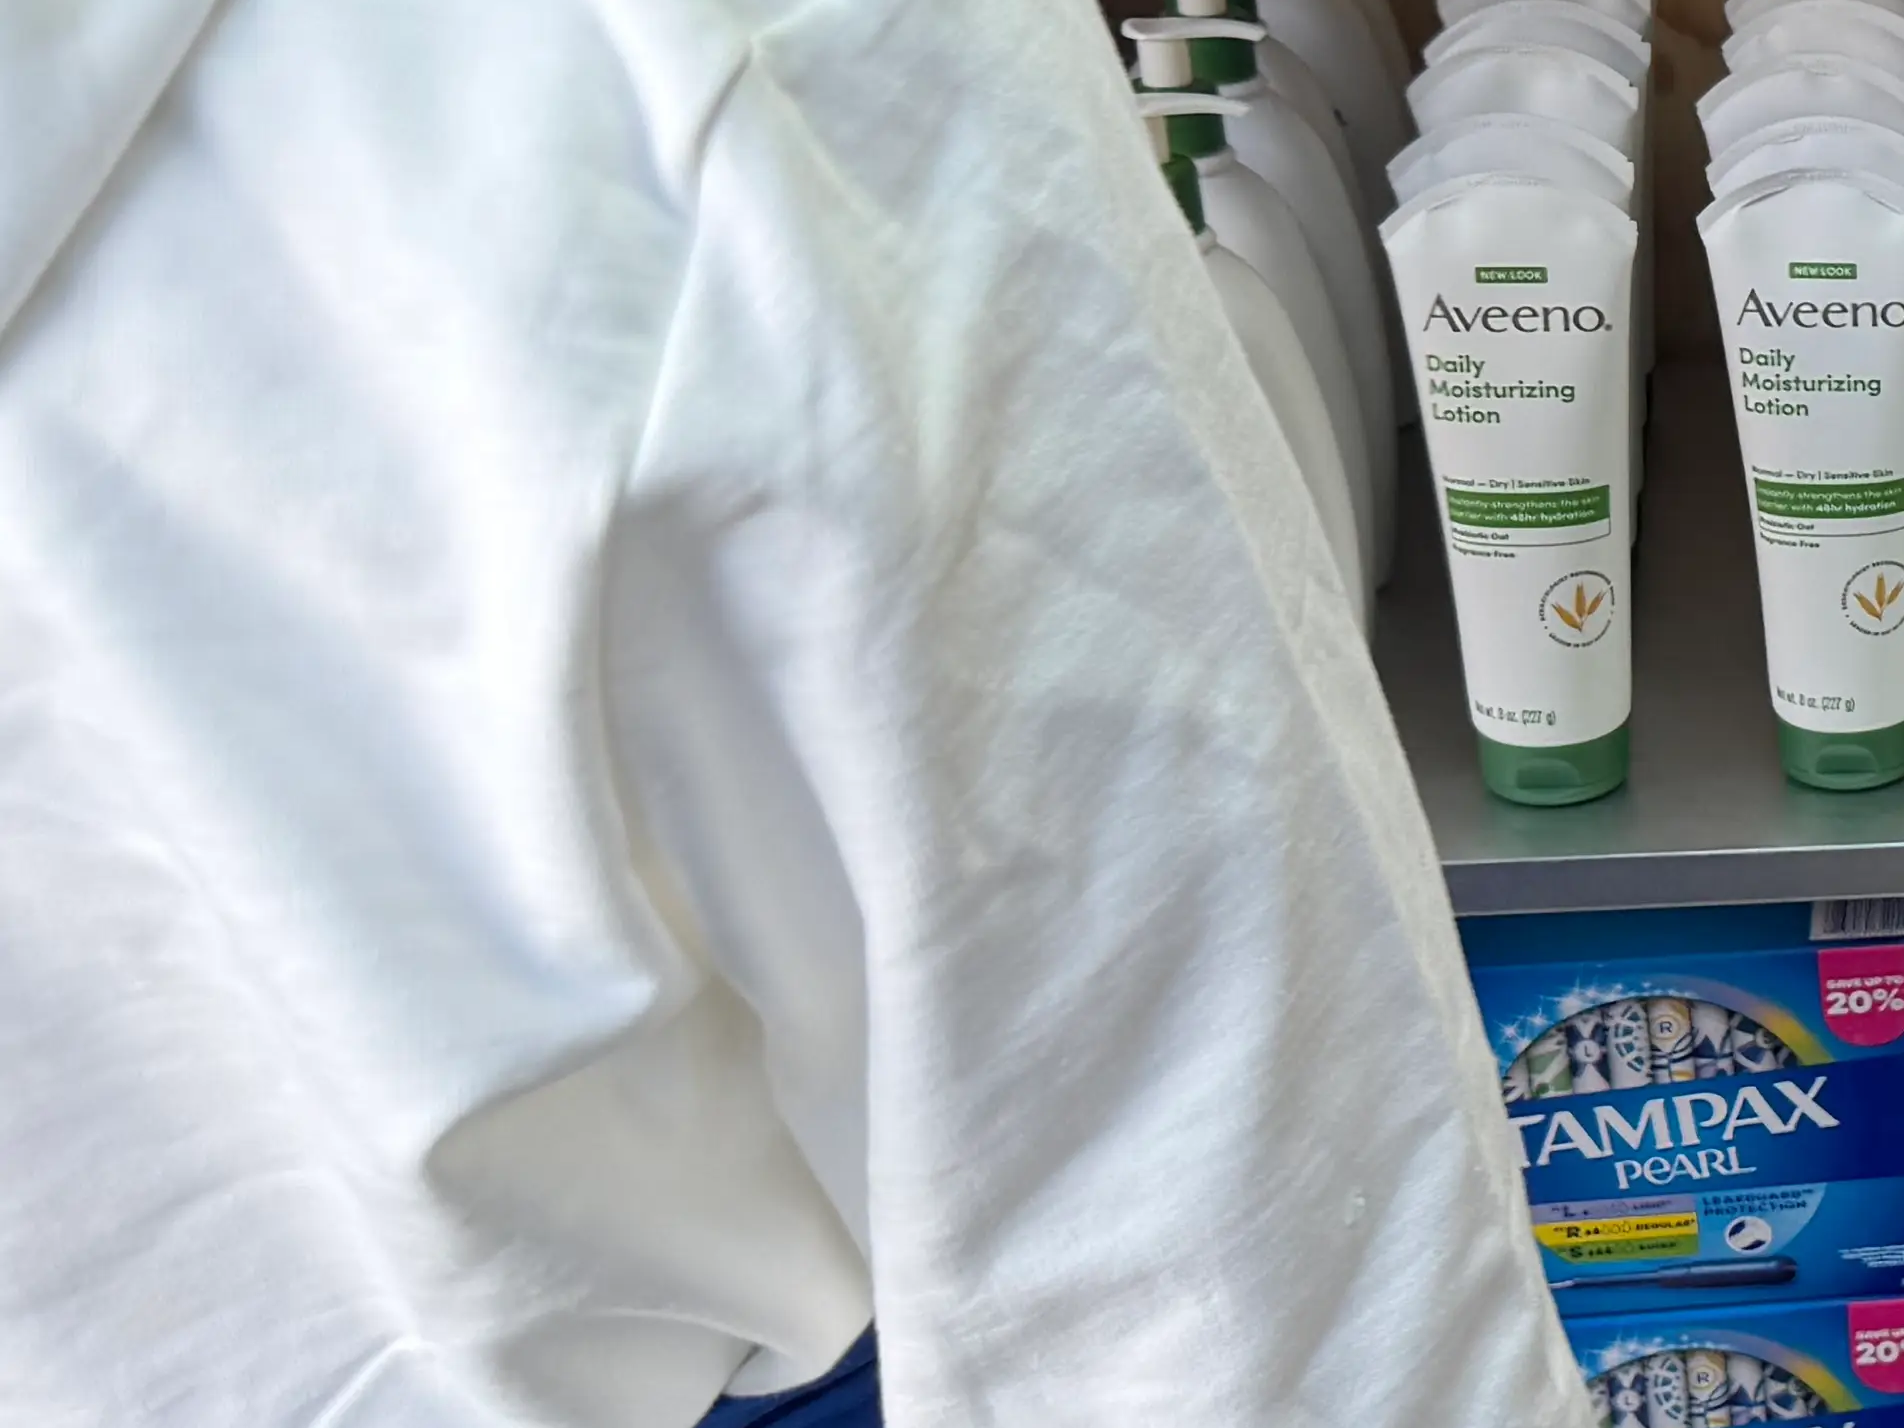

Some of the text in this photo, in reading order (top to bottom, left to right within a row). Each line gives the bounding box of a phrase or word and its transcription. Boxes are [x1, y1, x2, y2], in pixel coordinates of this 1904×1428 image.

[1480, 270, 1542, 281] NEW LOOK
[1426, 354, 1485, 378] Daily
[1739, 347, 1796, 372] Daily
[1430, 380, 1575, 402] Moisturizing
[1742, 371, 1882, 396] Moisturizing
[1433, 404, 1500, 423] Lotion
[1744, 395, 1810, 416] Lotion
[1816, 500, 1896, 514] 48hr hydration
